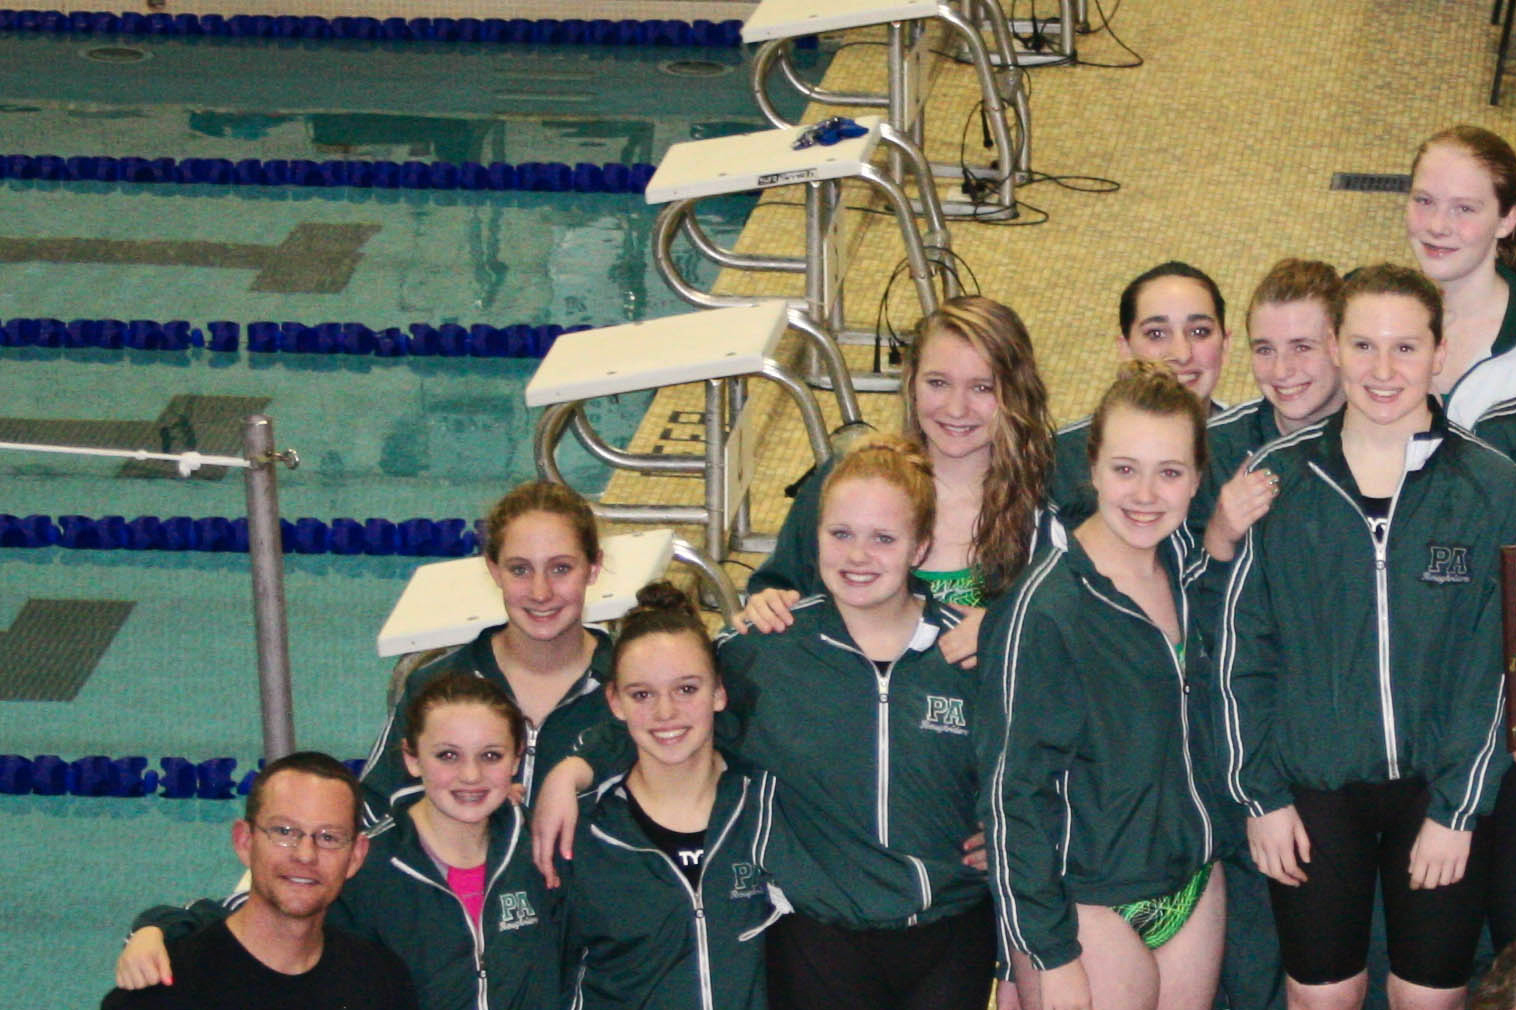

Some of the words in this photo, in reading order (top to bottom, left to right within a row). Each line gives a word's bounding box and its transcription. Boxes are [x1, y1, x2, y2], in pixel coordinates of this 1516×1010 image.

[1428, 546, 1468, 574] PA
[926, 695, 966, 727] PA
[500, 891, 536, 921] PA
